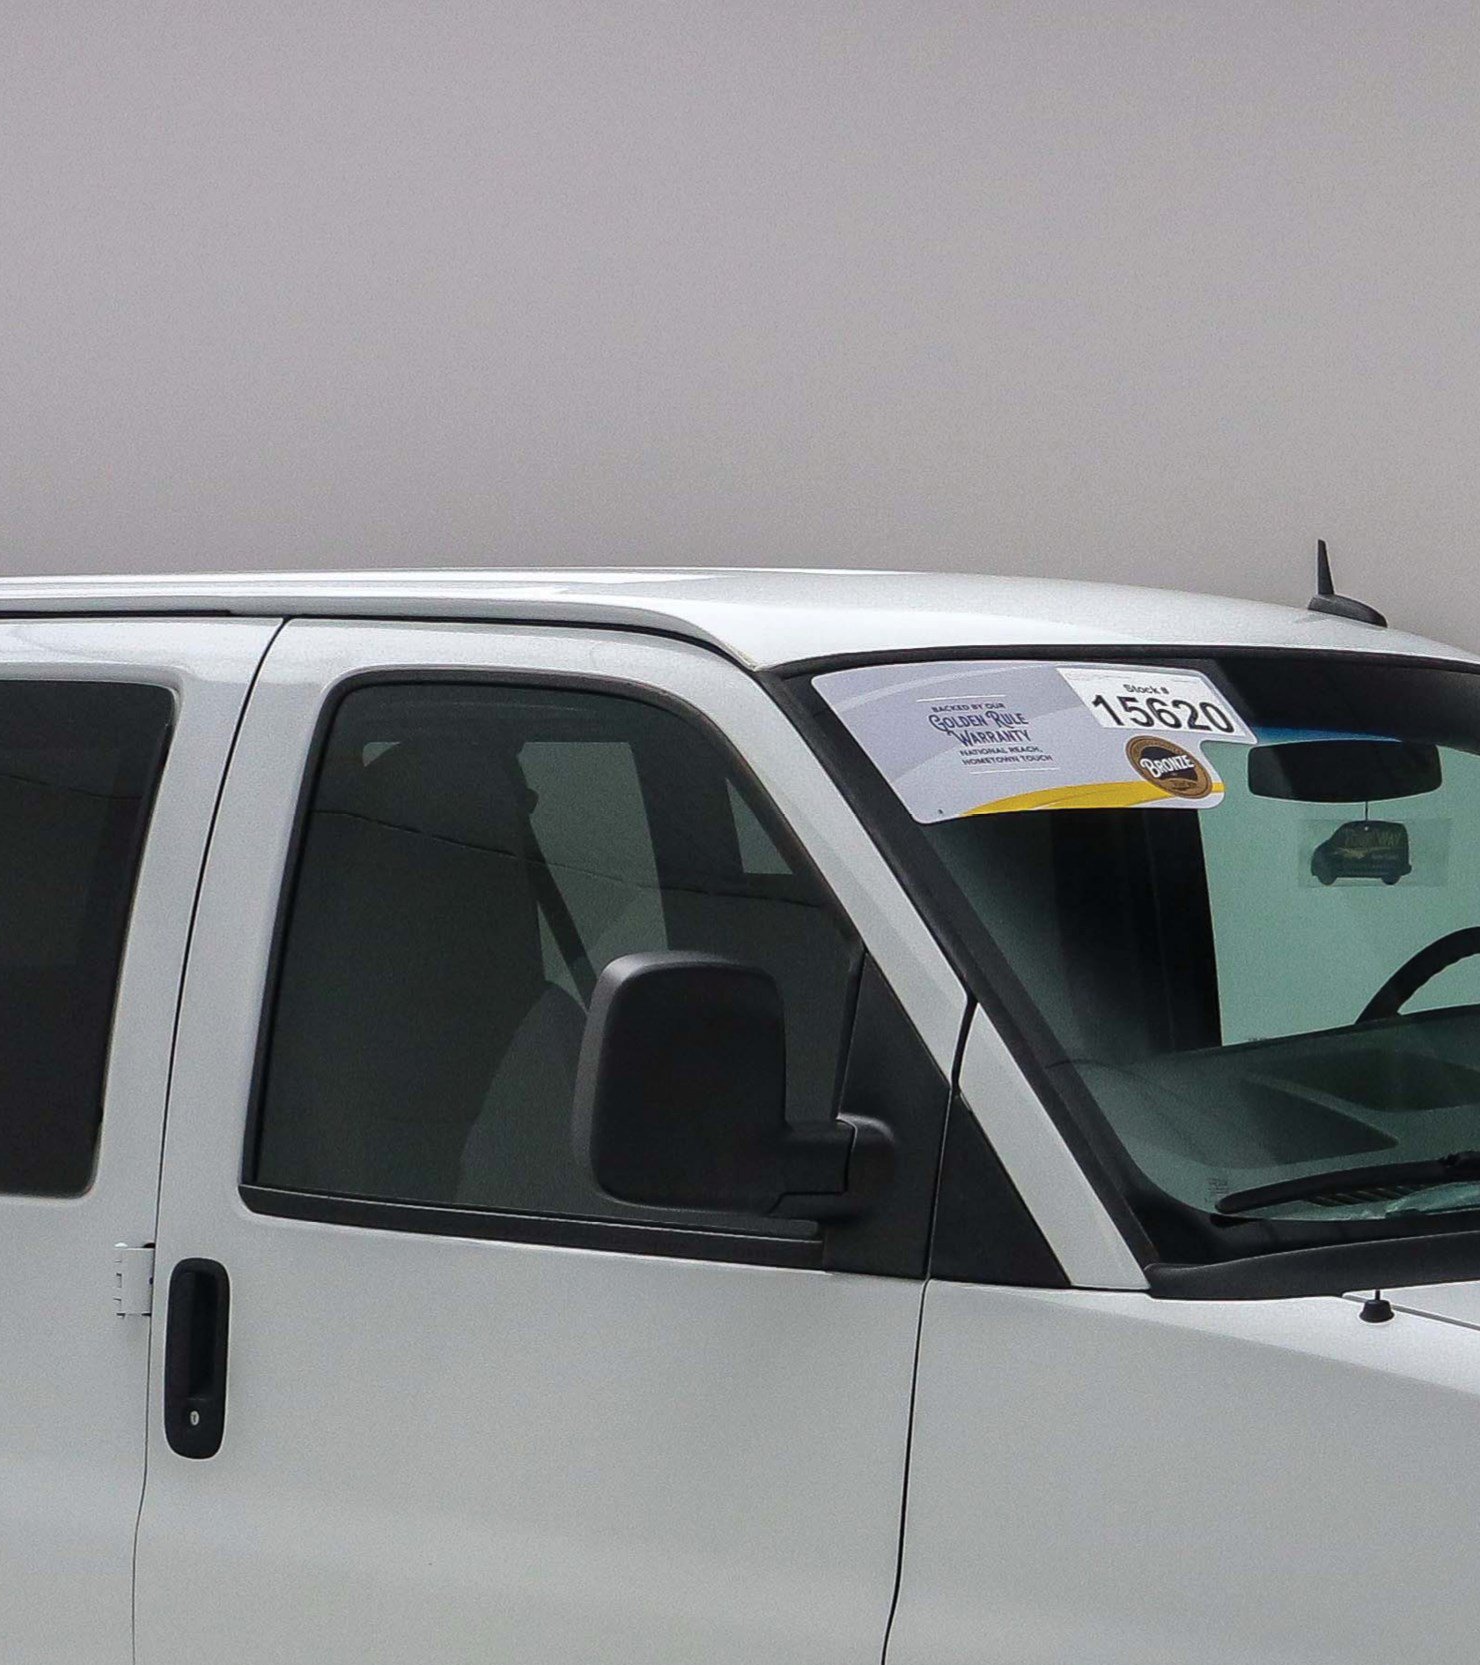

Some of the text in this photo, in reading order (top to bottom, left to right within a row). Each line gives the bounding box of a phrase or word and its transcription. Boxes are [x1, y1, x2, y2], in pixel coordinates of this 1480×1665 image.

[1123, 684, 1160, 695] Stock
[931, 704, 969, 713] BACKED
[1092, 694, 1235, 733] 15620
[928, 711, 1029, 732] GOLDEN RULE
[947, 729, 1032, 747] WARRANTY
[959, 748, 1008, 757] NATIONAL
[962, 756, 1021, 765] HOMETOWN
[1140, 754, 1195, 778] BRONZE
